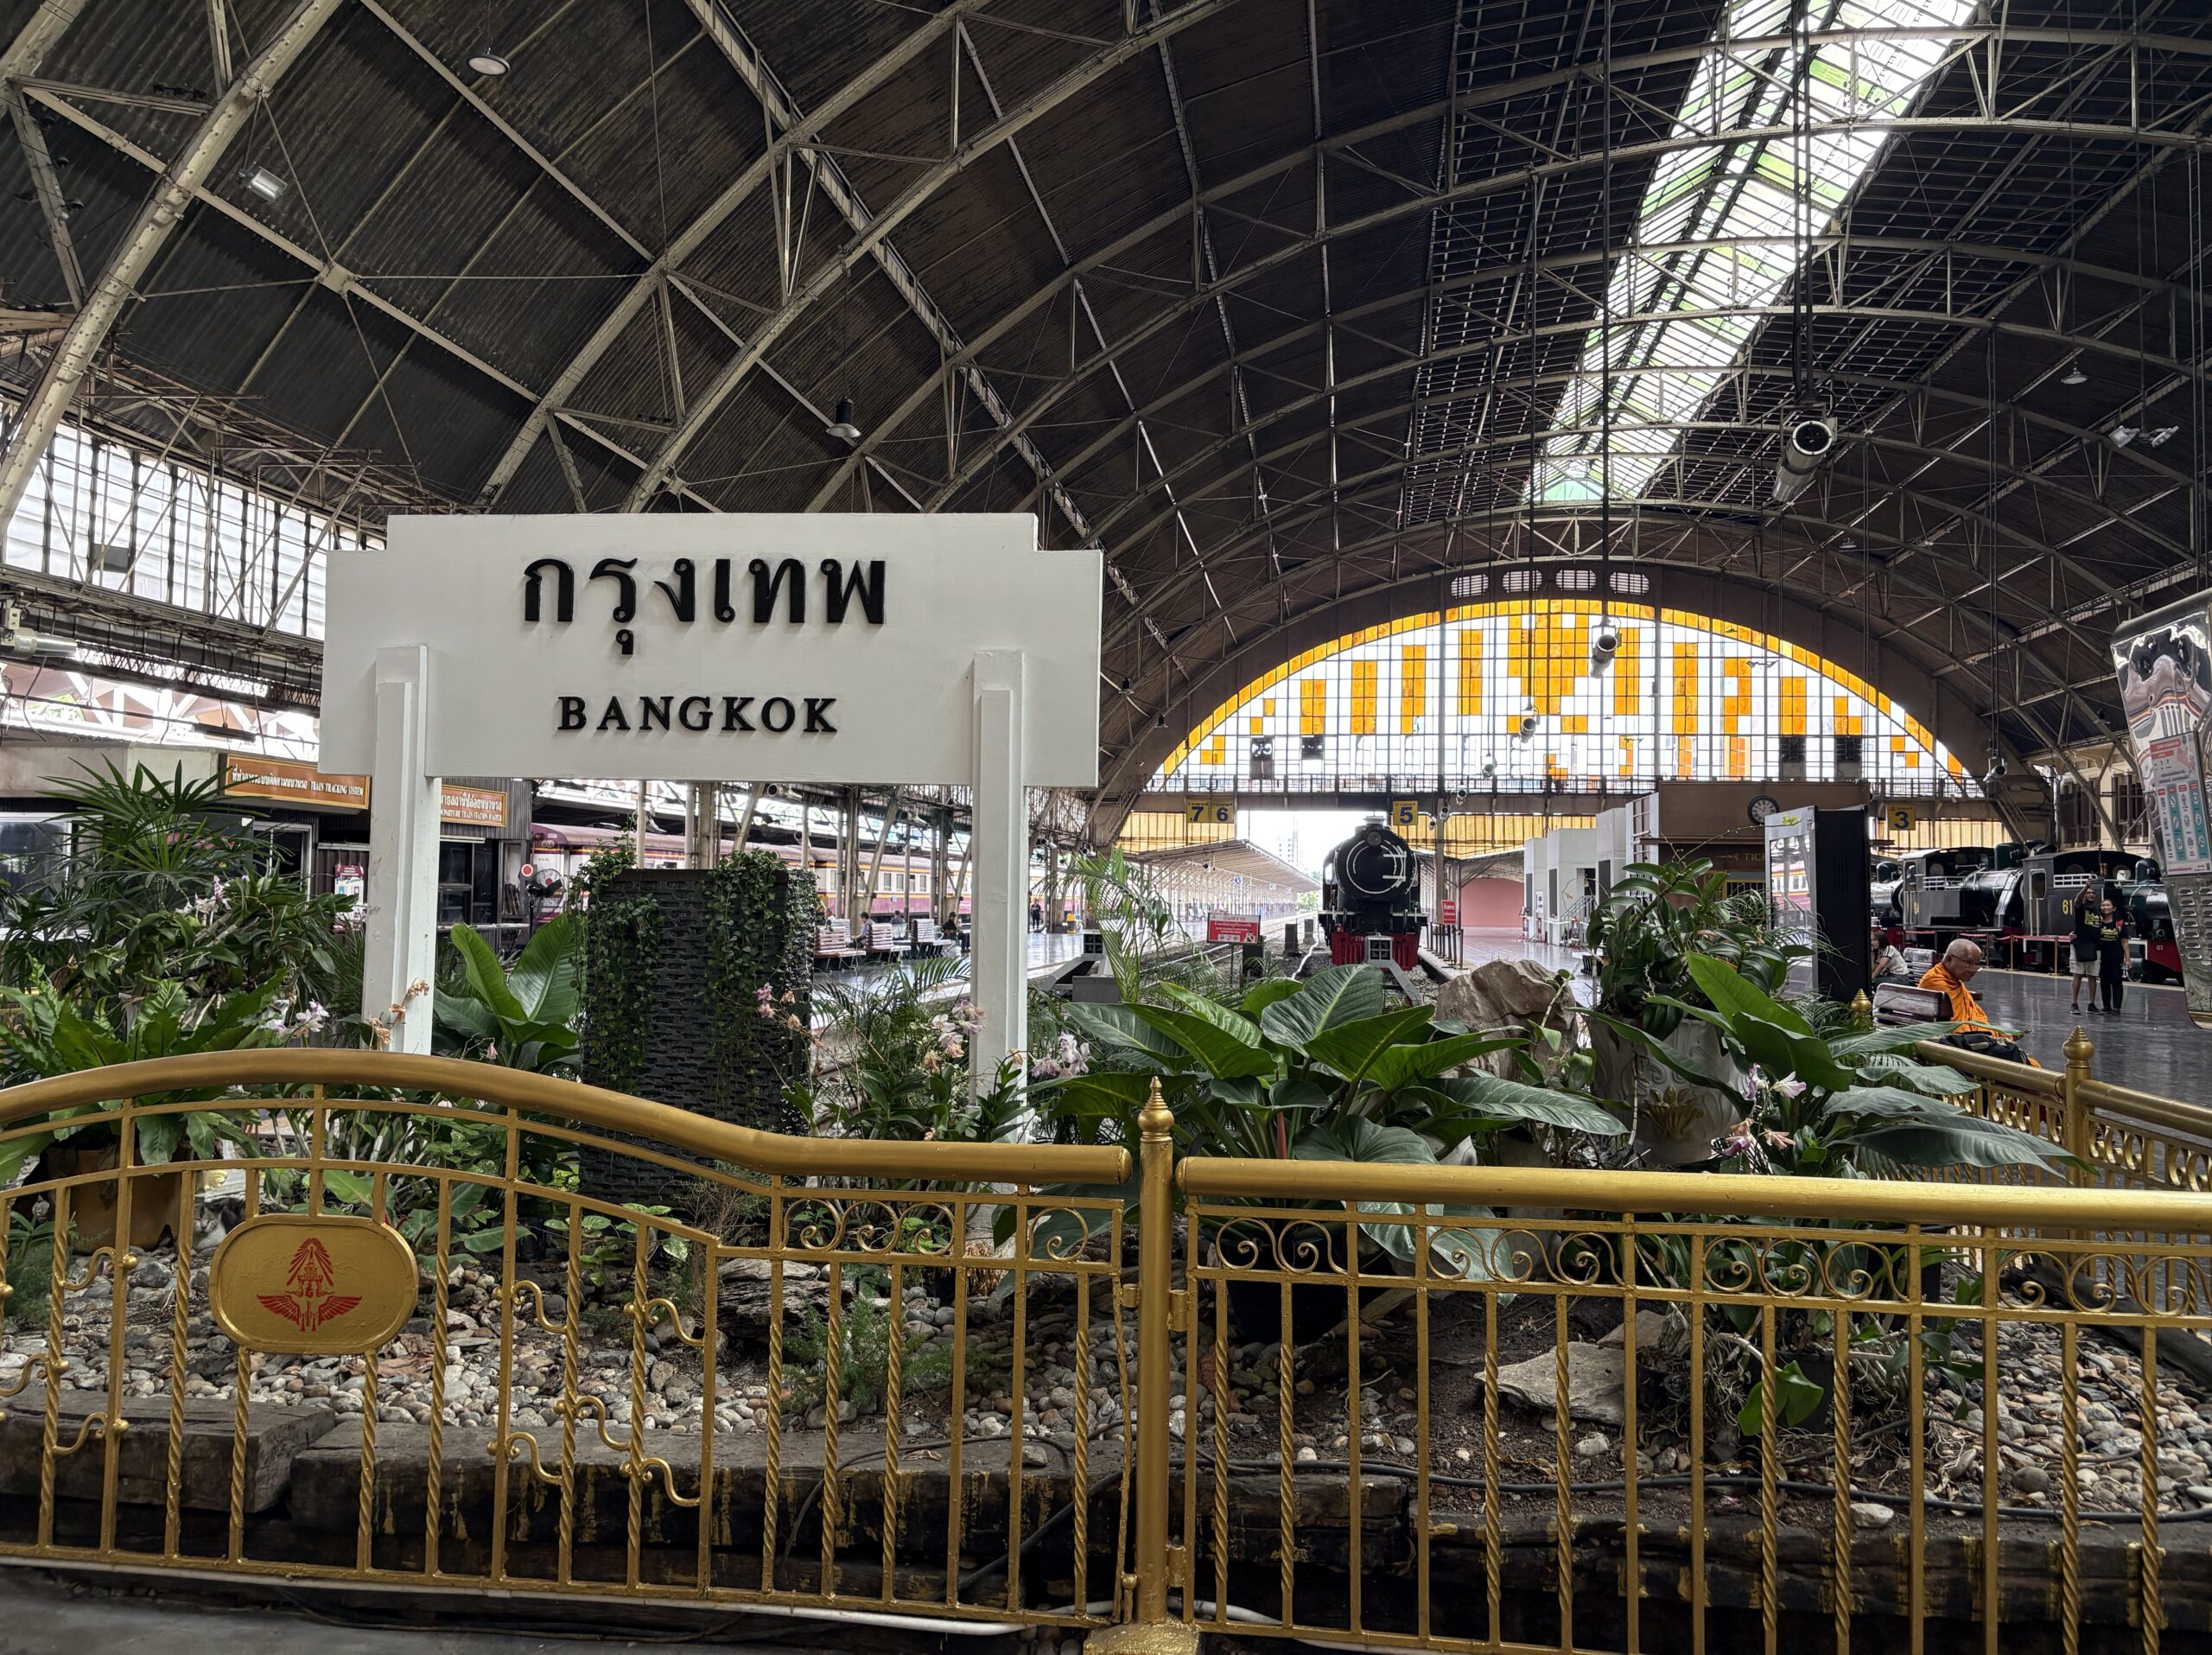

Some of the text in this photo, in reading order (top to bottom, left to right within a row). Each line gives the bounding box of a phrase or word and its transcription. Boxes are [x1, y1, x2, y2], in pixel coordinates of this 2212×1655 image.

[524, 557, 886, 654] กรุงเทพ
[557, 696, 837, 733] BANGKOK
[311, 780, 364, 796] TRAIN TRACKING SYSTEM
[1192, 805, 1204, 822] 7
[1216, 806, 1229, 822] 6
[1400, 806, 1414, 824] 5
[1894, 811, 1909, 829] 3
[2063, 899, 2073, 915] 61
